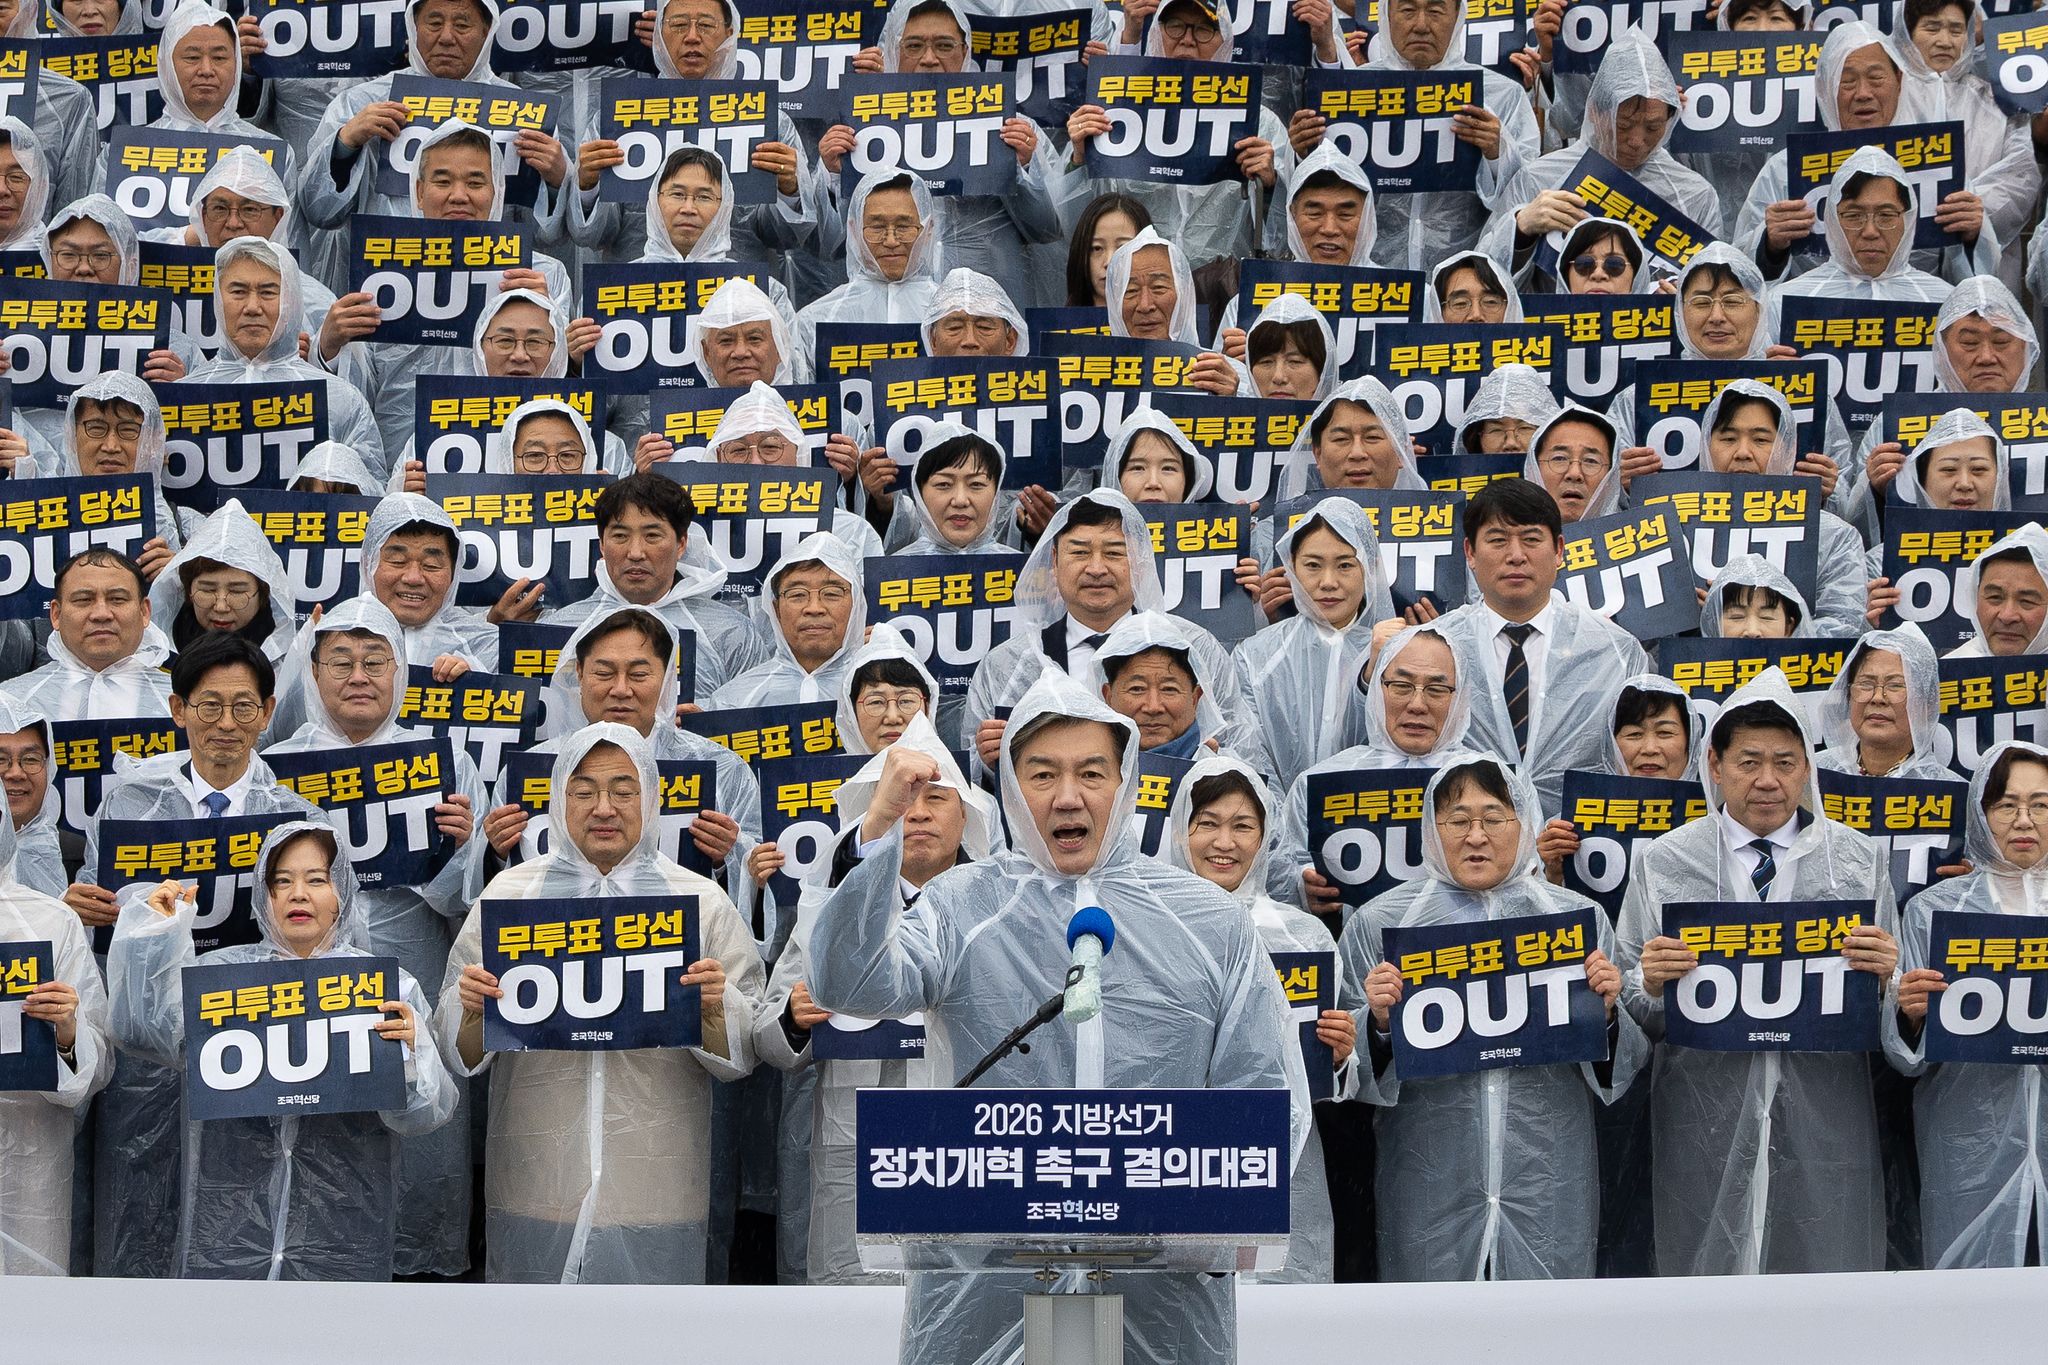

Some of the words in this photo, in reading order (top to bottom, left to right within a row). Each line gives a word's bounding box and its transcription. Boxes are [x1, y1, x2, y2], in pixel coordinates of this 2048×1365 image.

[259, 0, 407, 57] OUT
[495, 0, 645, 52] OUT
[737, 15, 796, 44] 투표
[807, 11, 861, 41] 당선
[972, 32, 1019, 55] 투표
[1029, 20, 1079, 51] 당선
[0, 50, 27, 78] 선
[40, 53, 98, 81] 투표
[108, 45, 158, 77] 당선
[317, 62, 351, 71] 조국혁신당
[554, 55, 588, 65] 조국혁신당
[1682, 48, 1766, 79] 무투표
[852, 90, 937, 122] 무투표
[947, 84, 1003, 115] 당선
[1098, 76, 1182, 104] 무투표
[1192, 76, 1249, 103] 당선
[1320, 88, 1405, 118] 무투표
[1416, 82, 1471, 113] 당선
[1681, 75, 1817, 131] OUT
[402, 96, 481, 123] 무투표
[488, 100, 547, 129] 당선
[614, 96, 698, 127] 무투표
[710, 91, 765, 122] 당선
[851, 117, 1004, 174] OUT
[1093, 107, 1247, 158] OUT
[1324, 117, 1457, 169] OUT
[1739, 136, 1774, 146] 조국혁신당
[1896, 133, 1951, 167] 당선
[122, 146, 207, 173] 무투표
[389, 126, 521, 176] OT
[1148, 166, 1184, 177] 조국혁신당
[1377, 176, 1412, 187] 조국혁신당
[1575, 175, 1660, 240] 무투표
[364, 238, 452, 266] 무투표
[463, 235, 520, 265] 당선
[141, 265, 216, 293] 무투표
[359, 270, 507, 321] OUT
[0, 301, 87, 329] 무투표
[98, 300, 157, 329] 당선
[597, 281, 686, 316] 무투표
[1352, 282, 1411, 312] 당선
[421, 329, 458, 339] 조국혁신당
[1612, 307, 1671, 339] 당선
[1794, 318, 1884, 348] 무투표
[0, 334, 155, 385] OUT
[595, 317, 697, 371] OU
[1390, 342, 1480, 376] 무투표
[1492, 336, 1551, 369] 당선
[658, 377, 695, 387] 조국혁신당
[1059, 356, 1142, 386] 무투표
[886, 375, 976, 412] 무투표
[988, 370, 1046, 402] 당선
[160, 402, 241, 435] 무투표
[253, 393, 313, 427] 당선
[664, 408, 724, 443] 무투
[786, 397, 827, 429] 선
[162, 428, 315, 489] OUT
[0, 496, 68, 533] 투표
[80, 486, 141, 524] 당선
[443, 493, 533, 526] 무투표
[545, 488, 605, 522] 당선
[681, 483, 749, 514] 투표
[759, 481, 822, 512] 당선
[1644, 492, 1732, 523] 투표
[1743, 489, 1806, 522] 당선
[337, 512, 369, 542] 당
[1176, 517, 1237, 551] 당선
[1391, 504, 1453, 537] 당선
[1605, 514, 1668, 560] 당선
[460, 525, 601, 583] OUT
[711, 518, 820, 573] UT
[1684, 527, 1805, 580] UT
[1898, 530, 1994, 563] 무투표
[879, 574, 972, 611] 무투표
[1780, 652, 1843, 687] 당선
[400, 687, 453, 719] 투표
[463, 689, 524, 722] 당선
[1939, 677, 1993, 713] 투표
[802, 718, 843, 752] 당
[374, 752, 440, 794] 당선
[777, 779, 845, 818] 무투
[1323, 788, 1423, 824] 무투표
[1573, 798, 1672, 831] 무투표
[1885, 795, 1952, 828] 당선
[330, 792, 443, 863] UT
[114, 839, 216, 877] 무투표
[229, 830, 272, 867] 당
[1322, 827, 1424, 885] OU
[357, 872, 382, 882] 혁신당
[194, 938, 219, 947] 혁신당
[498, 918, 601, 960] 무투표
[615, 910, 683, 949] 당선
[1680, 923, 1782, 960] 무투표
[1796, 914, 1861, 952] 당선
[1401, 939, 1504, 985] 무투표
[1516, 924, 1584, 966] 당선
[1946, 938, 2048, 972] 무투표
[200, 981, 305, 1026] 무투표
[318, 972, 384, 1011] 당선
[497, 951, 684, 1025] OUT
[1276, 966, 1317, 1001] 선
[1677, 956, 1854, 1024] OUT
[1403, 964, 1587, 1050] OUT
[1940, 977, 2048, 1035] OU
[200, 1013, 386, 1091] OUT
[570, 1030, 614, 1042] 조국혁신당
[1747, 1031, 1791, 1043] 조국혁신당
[1480, 1047, 1522, 1061] 조국혁신당
[277, 1094, 320, 1106] 조국혁신당
[974, 1103, 1043, 1136] 2026
[1051, 1103, 1174, 1136] 지방선거
[870, 1147, 1024, 1188] 정치개혁
[1035, 1147, 1112, 1188] 촉구
[1123, 1147, 1277, 1188] 결의대회
[1027, 1200, 1120, 1223] 조국혁신당
